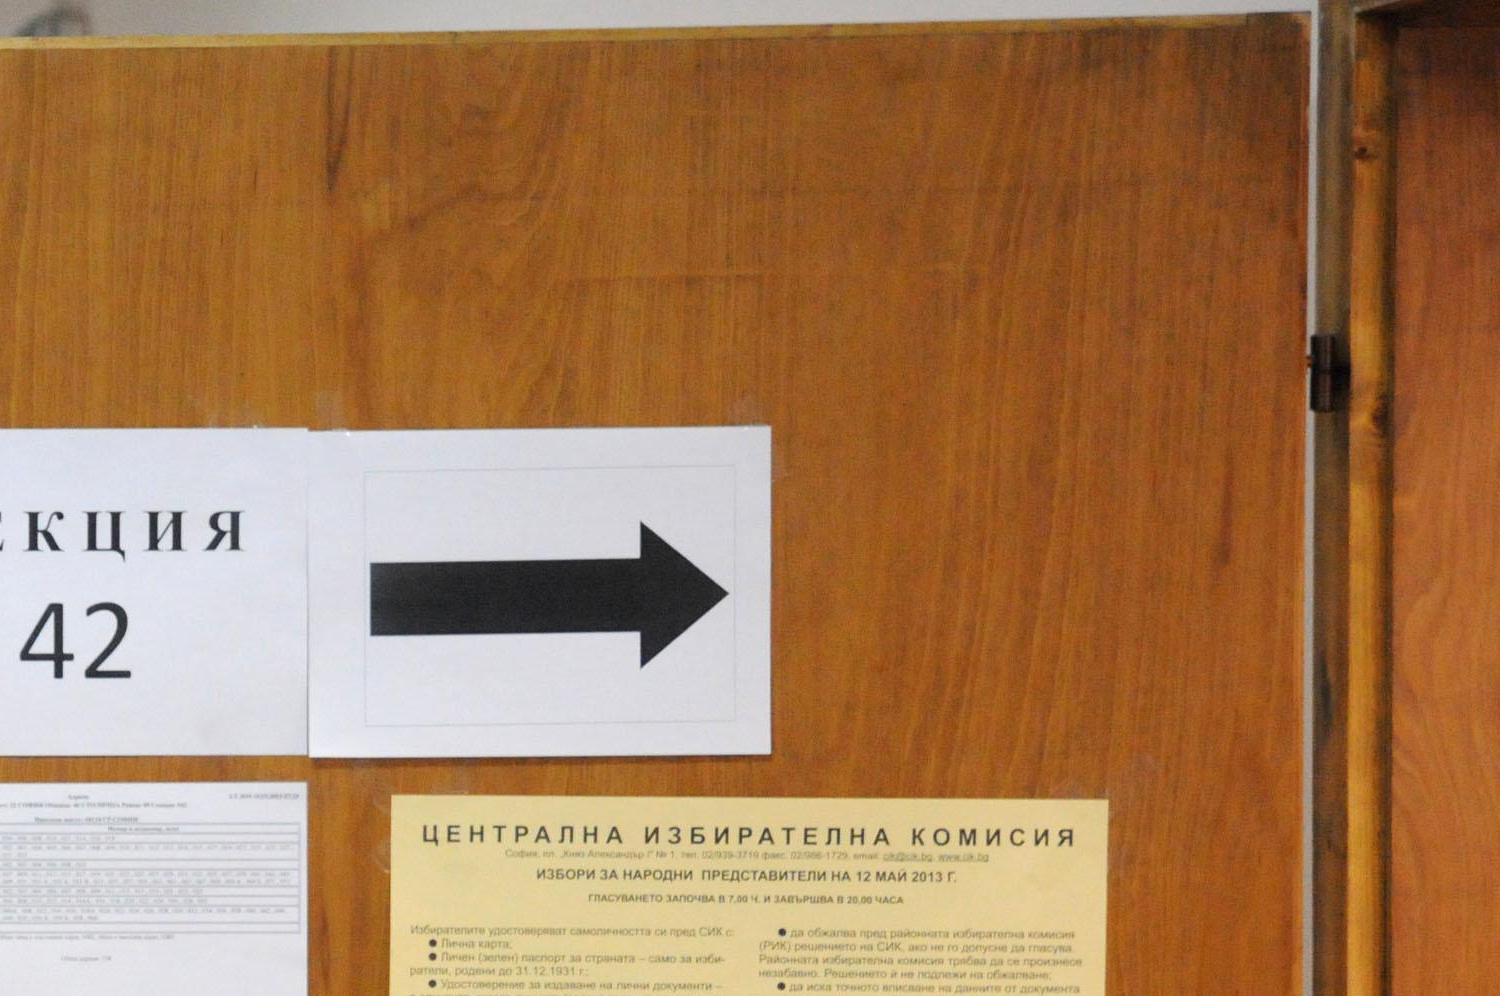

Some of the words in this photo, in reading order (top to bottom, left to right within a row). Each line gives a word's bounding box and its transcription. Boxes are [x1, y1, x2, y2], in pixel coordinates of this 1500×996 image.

[19, 602, 133, 679] 42
[422, 823, 623, 846] ЦЕНТРАЛНА
[644, 824, 890, 845] ИЗБИРАТЕЛНА
[911, 826, 1073, 846] КОМИСИЯ
[536, 867, 596, 880] ИЗБОРИ
[599, 868, 619, 880] ЗА
[622, 868, 693, 883] НАРОДНИ
[701, 868, 827, 883] ПРЕДСТАВИТЕЛИ
[830, 869, 851, 882] НА
[856, 870, 871, 882] 12
[874, 867, 907, 882] МАЙ
[911, 870, 943, 882] 2013
[587, 892, 664, 902] ГЛАСУВАНЕТО
[665, 893, 715, 903] ЗАПОЧВА
[717, 893, 726, 903] В
[763, 894, 771, 903] И
[773, 894, 834, 904] ЗАВЪРШВА
[836, 894, 844, 904] В
[874, 895, 904, 904] ЧАСА
[409, 924, 486, 937] Избирателите
[487, 927, 567, 938] удостоверяват
[569, 927, 652, 936] самоличността
[653, 928, 667, 936] си
[669, 928, 696, 938] пред
[698, 926, 723, 936] СИК
[440, 937, 476, 948] Лична
[440, 951, 475, 962] Личен
[477, 952, 519, 964] (зелен)
[520, 954, 566, 964] паспорт
[568, 954, 582, 963] за
[584, 954, 636, 965] страната
[647, 955, 677, 963] само
[679, 955, 692, 964] за
[694, 953, 725, 964] изби-
[454, 967, 496, 978] родени
[497, 967, 513, 978] до
[515, 964, 575, 975] 31.12.1931
